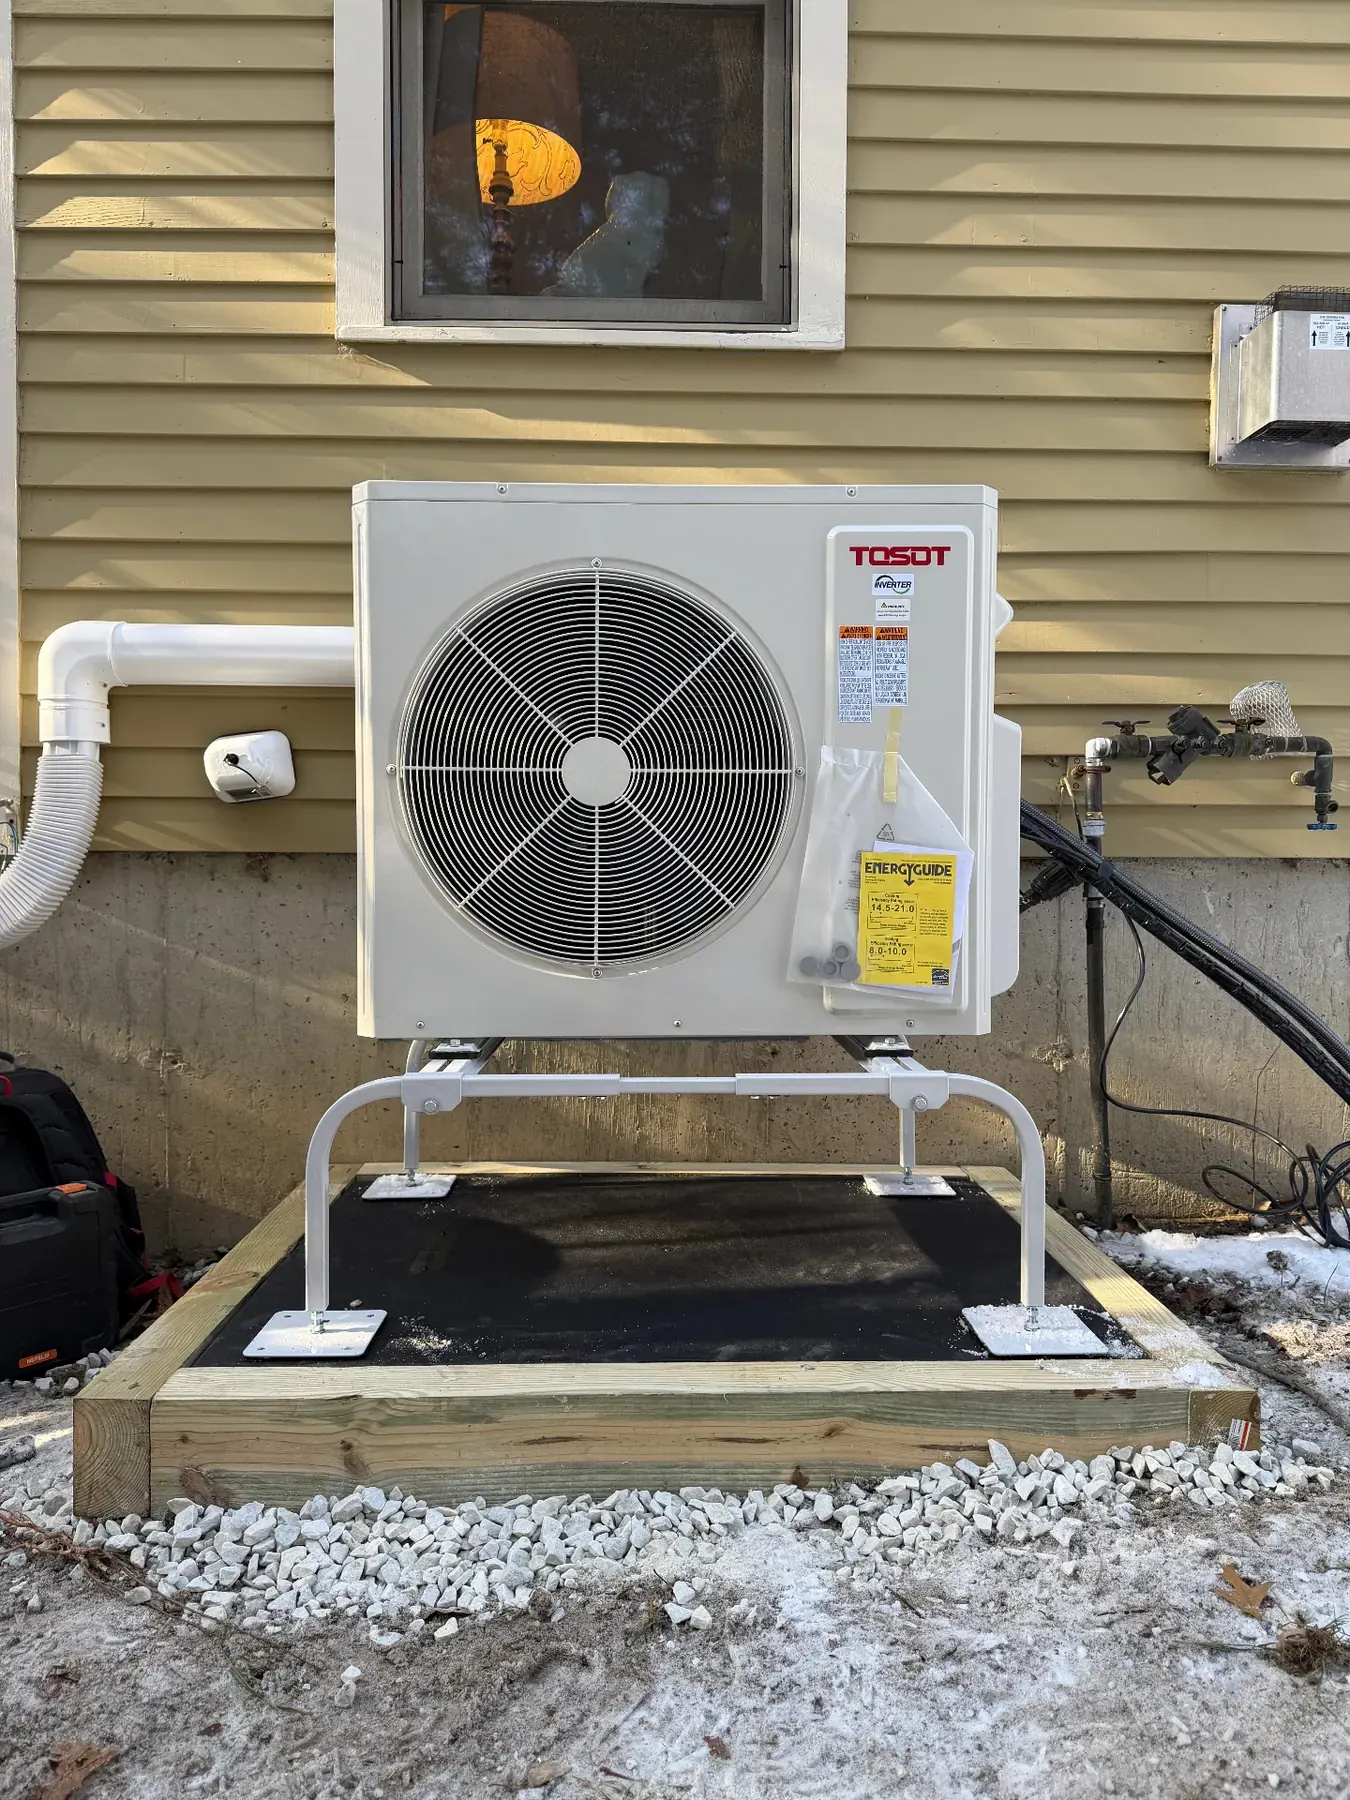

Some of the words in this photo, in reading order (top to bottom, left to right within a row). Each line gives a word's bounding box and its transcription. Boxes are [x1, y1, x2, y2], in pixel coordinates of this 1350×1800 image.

[849, 546, 951, 566] TOSOT
[874, 581, 912, 589] INVERTER
[865, 862, 952, 878] ENERGYGUIDE
[871, 904, 915, 913] 14.5-21.0
[869, 946, 907, 956] 8.0-10.0
